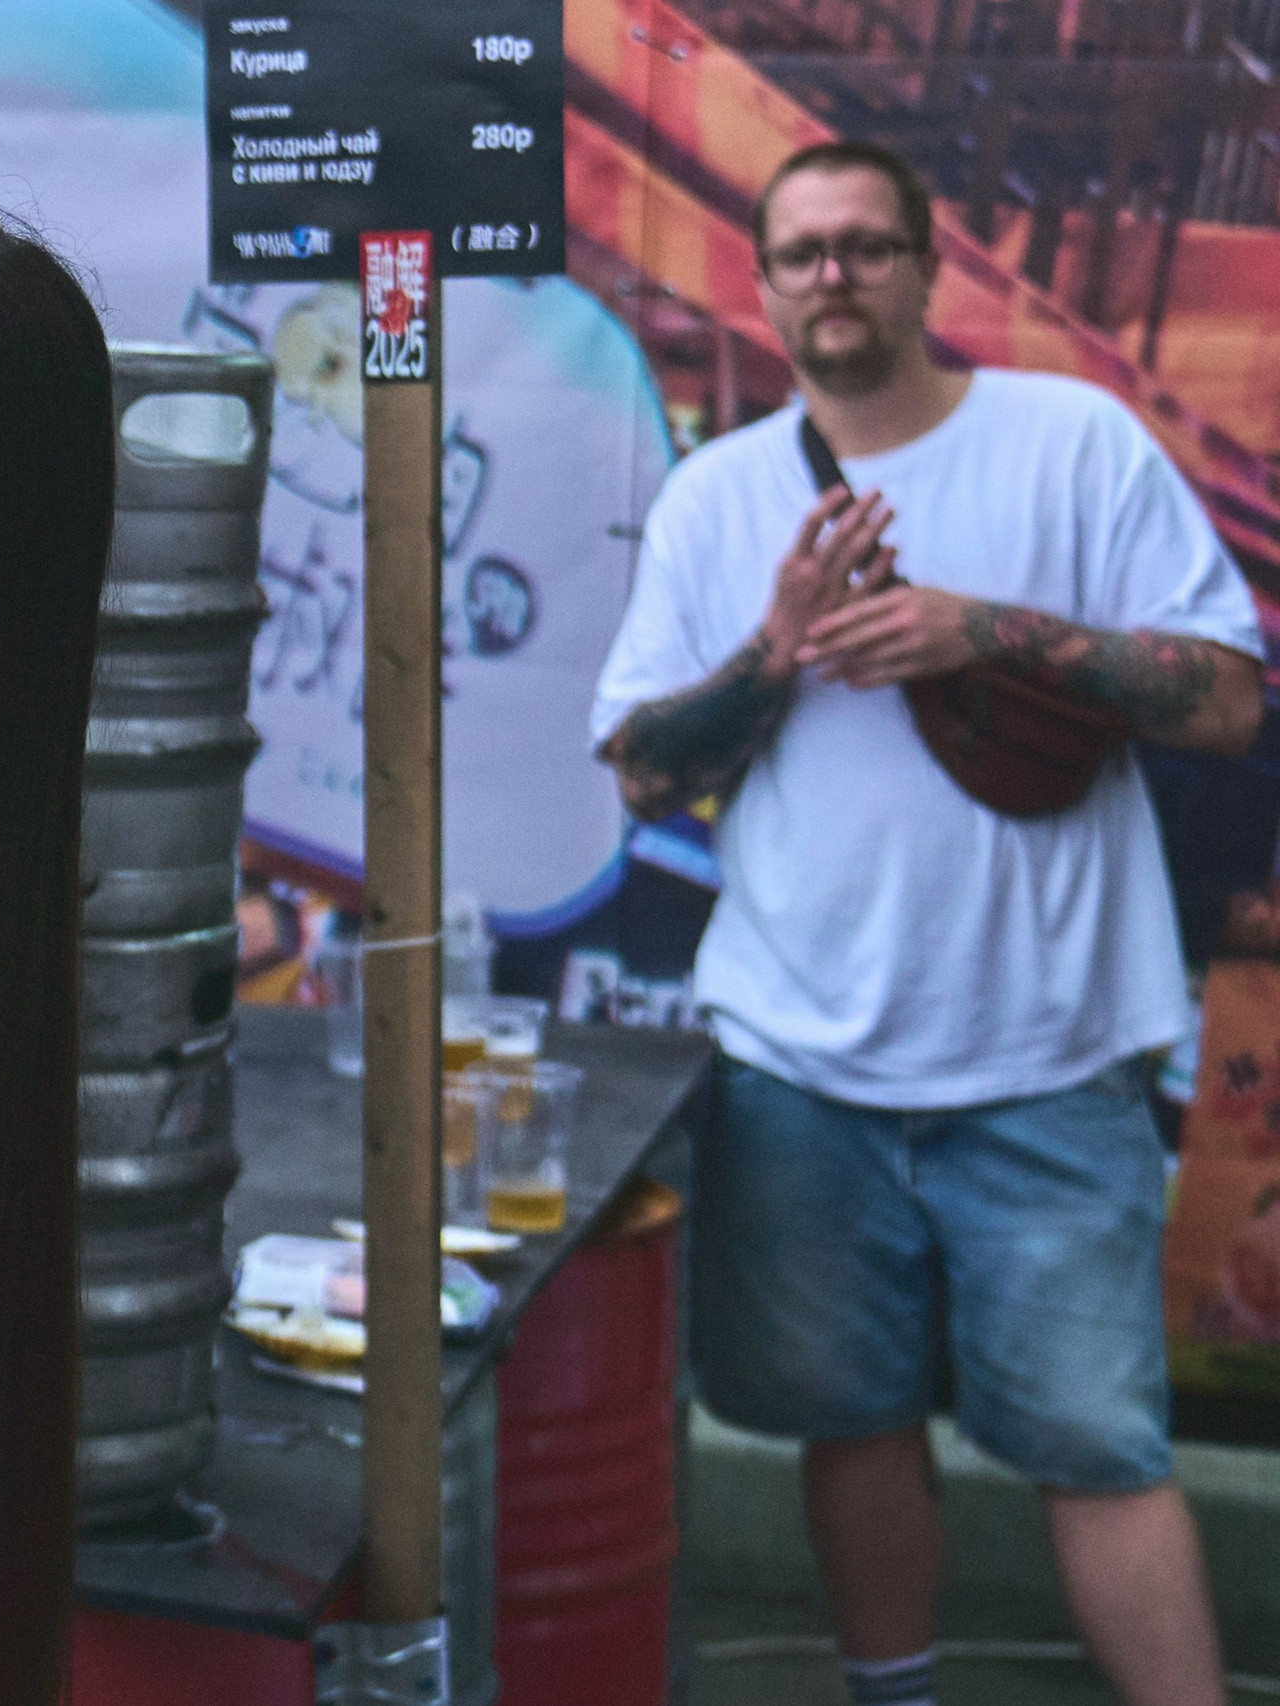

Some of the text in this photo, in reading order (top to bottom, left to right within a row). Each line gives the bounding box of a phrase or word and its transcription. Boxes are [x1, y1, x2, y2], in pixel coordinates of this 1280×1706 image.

[231, 49, 307, 78] Курица
[233, 131, 338, 159] Холодный
[341, 128, 379, 154] чай
[232, 160, 374, 185] с киви и юдзу
[365, 319, 427, 378] 2025
